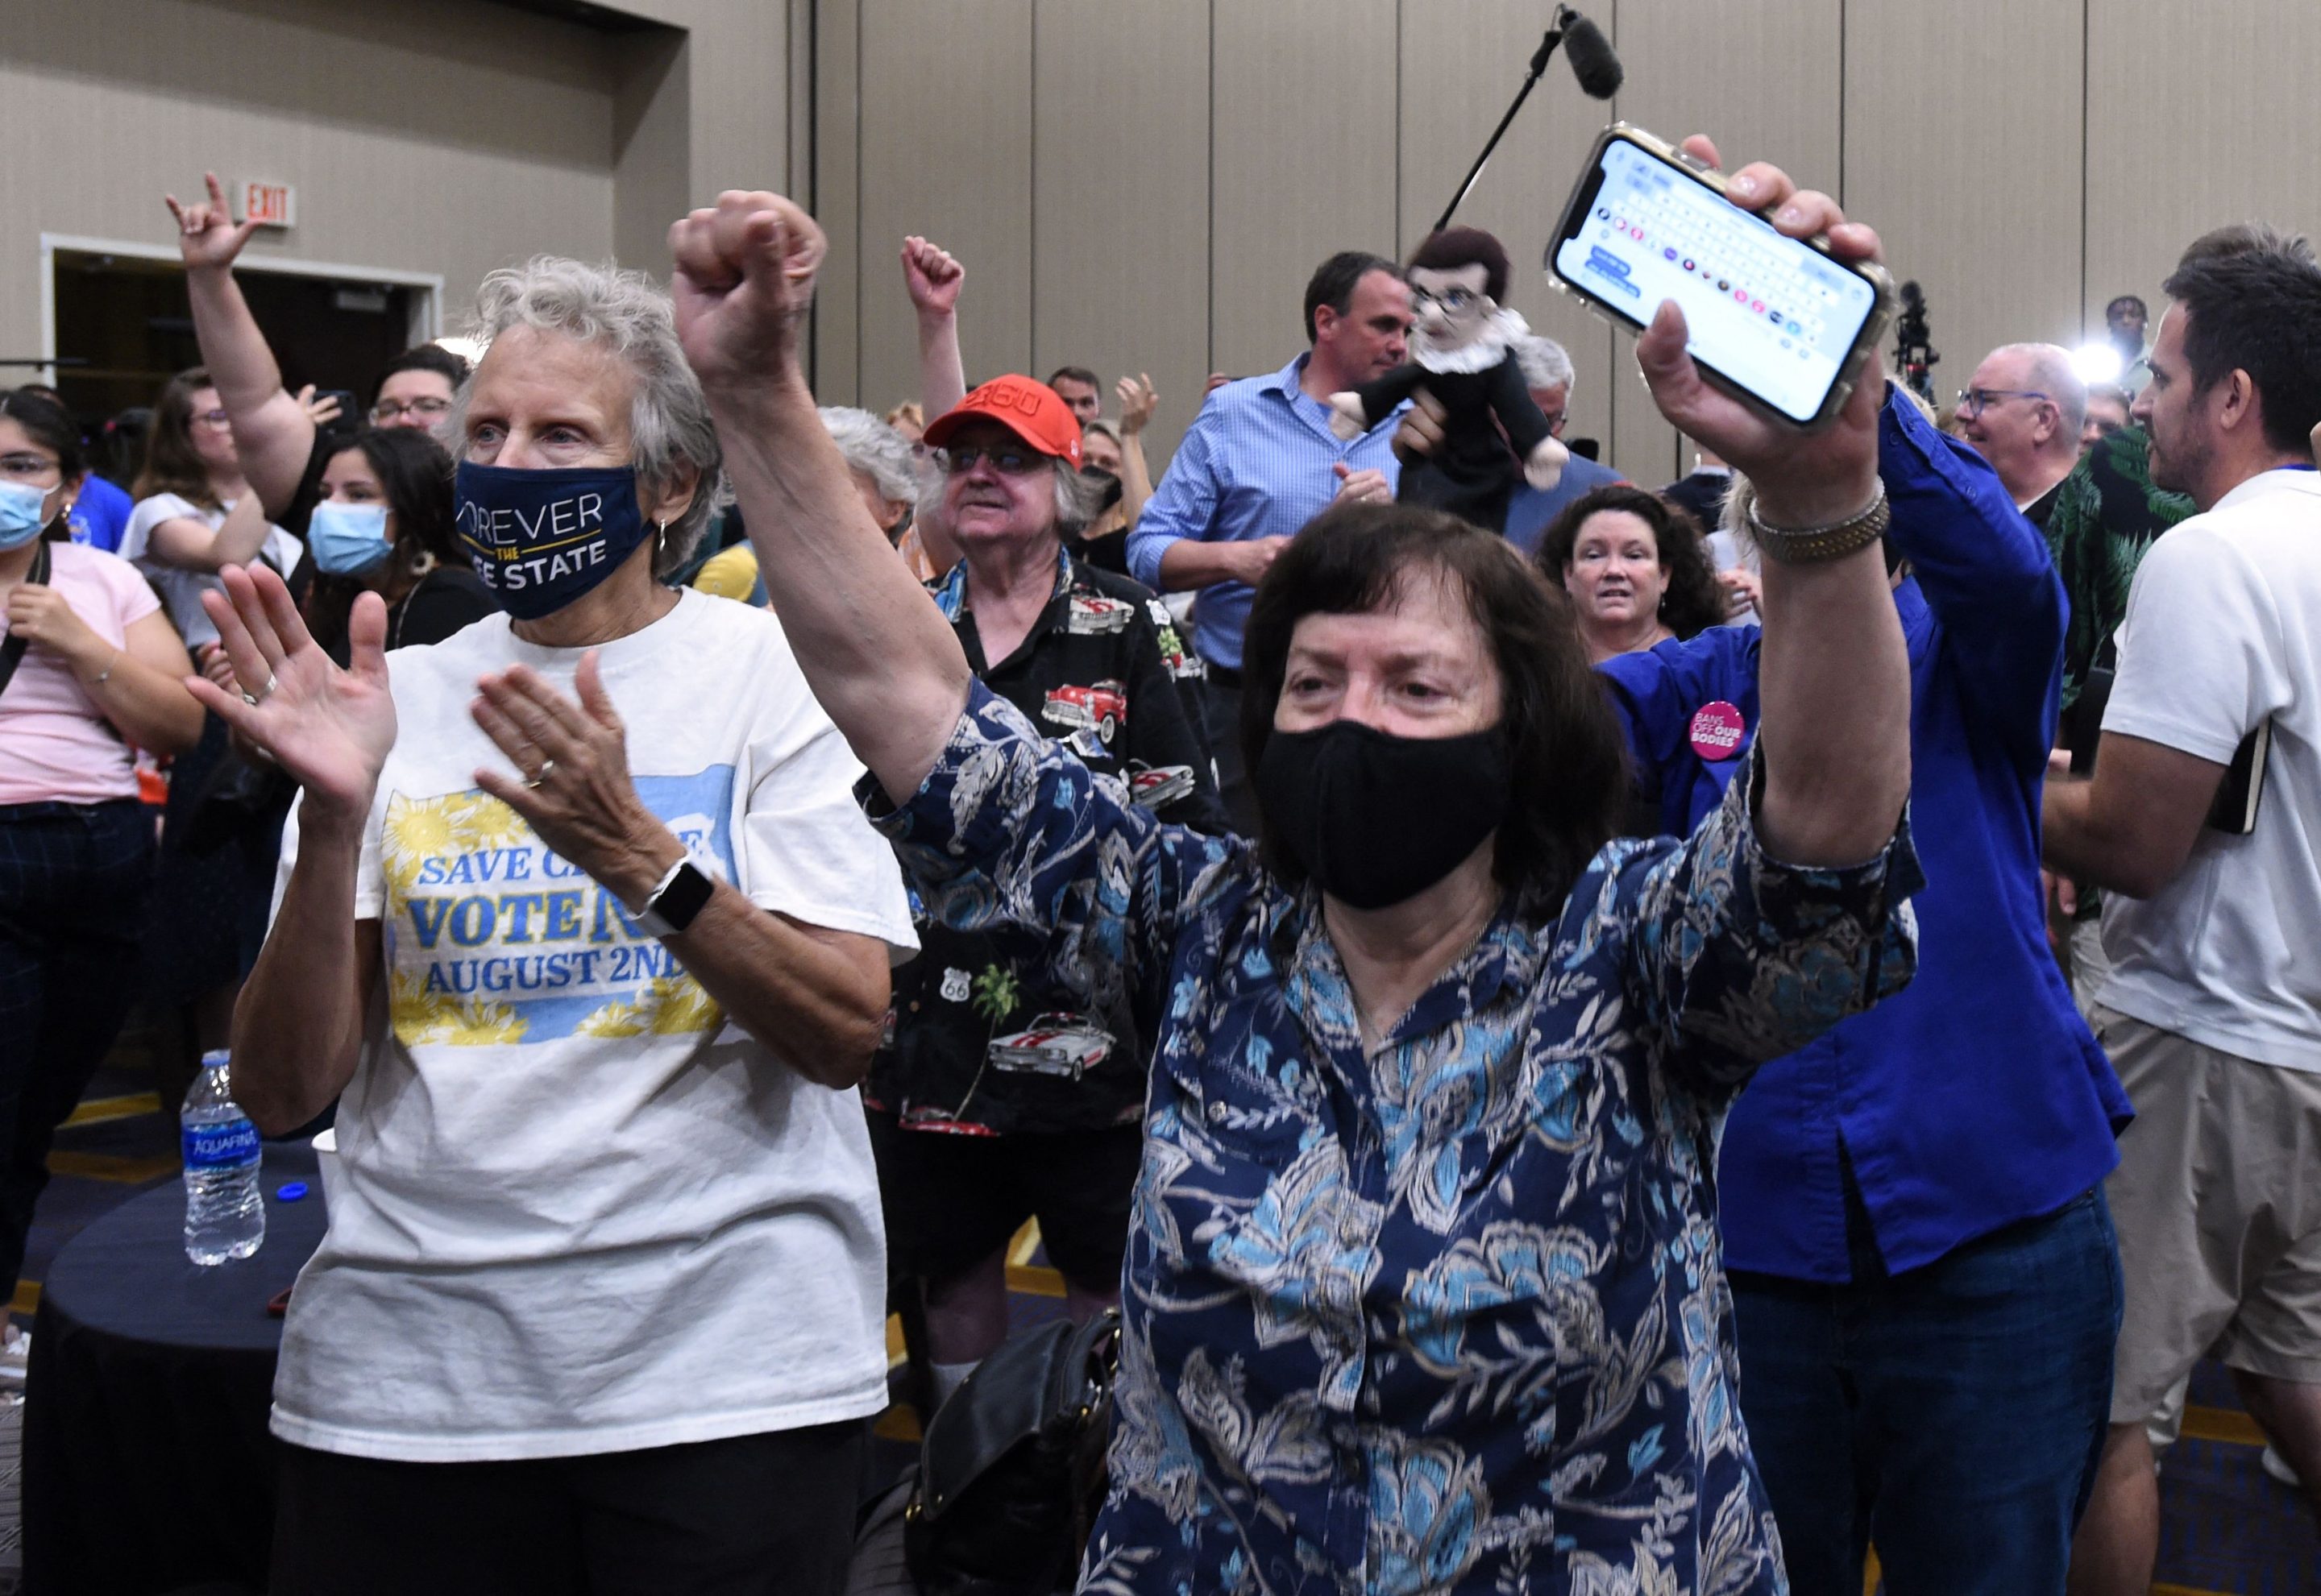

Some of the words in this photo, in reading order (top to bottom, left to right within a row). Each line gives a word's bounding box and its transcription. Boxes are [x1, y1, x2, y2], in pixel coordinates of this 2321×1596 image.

[247, 184, 287, 220] EXIT
[455, 492, 603, 545] OREVER
[495, 546, 520, 561] THE
[504, 539, 606, 590] STATE
[1693, 722, 1715, 735] OFF
[1714, 726, 1741, 739] OUR
[1695, 712, 1724, 726] BANS
[1691, 732, 1734, 748] BODIES
[418, 847, 532, 884] SAVE
[406, 887, 583, 950] VOTE
[426, 949, 601, 994] AUGUST
[945, 980, 967, 998] 66
[193, 1130, 258, 1155] AQUAFINA
